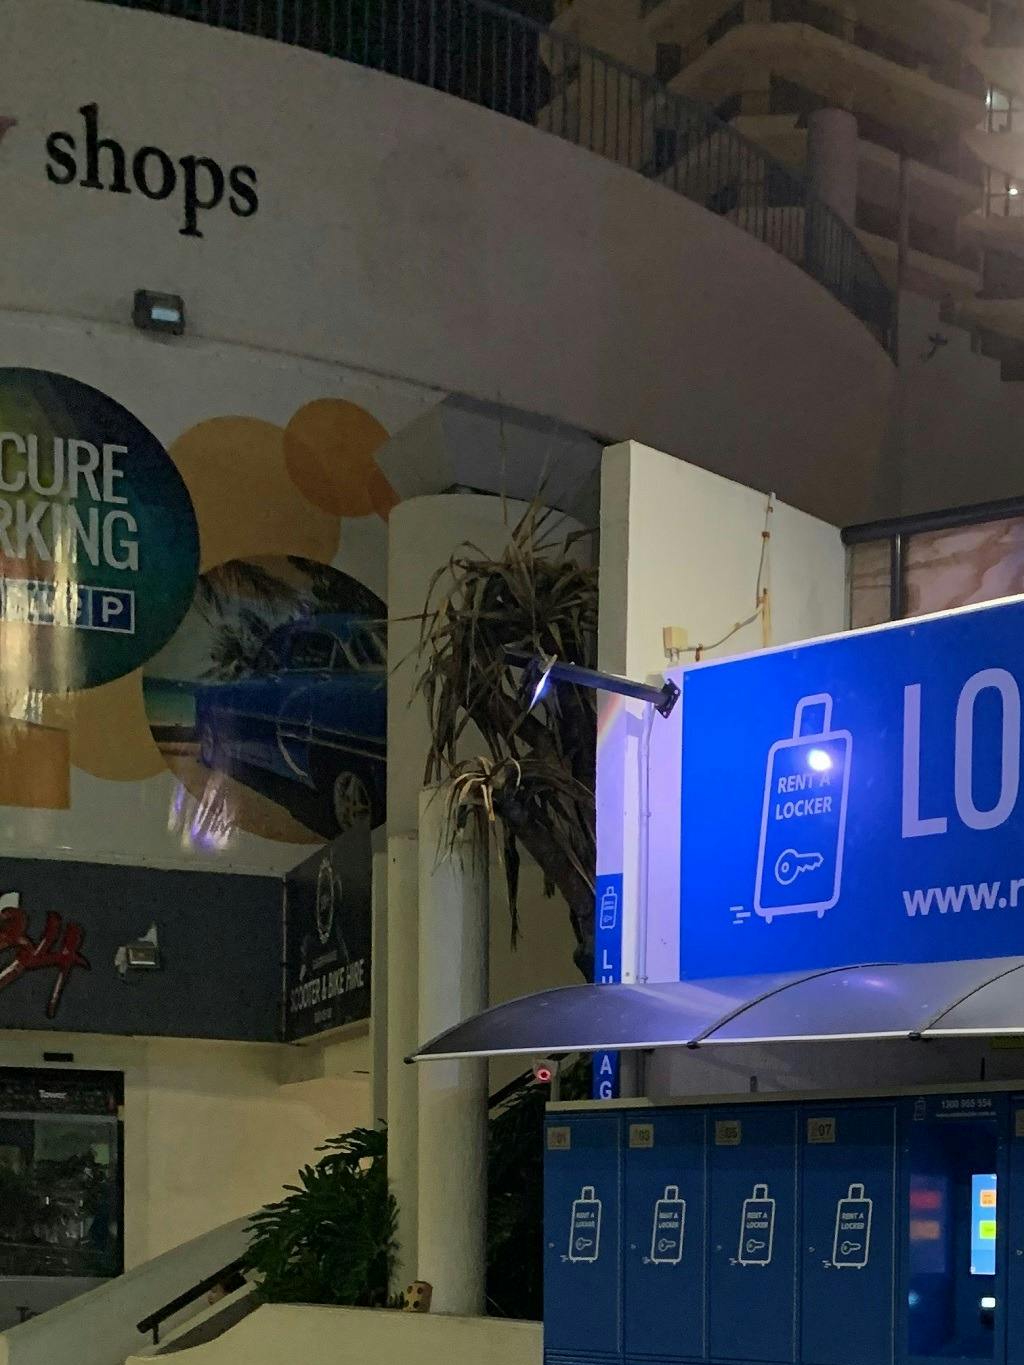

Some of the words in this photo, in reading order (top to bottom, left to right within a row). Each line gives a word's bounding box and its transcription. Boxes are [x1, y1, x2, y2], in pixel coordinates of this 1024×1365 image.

[46, 102, 258, 238] shops
[0, 431, 128, 504] CURE
[102, 596, 123, 622] P
[778, 774, 813, 794] RENT
[775, 796, 832, 821] LOCKER
[818, 1124, 832, 1136] 07
